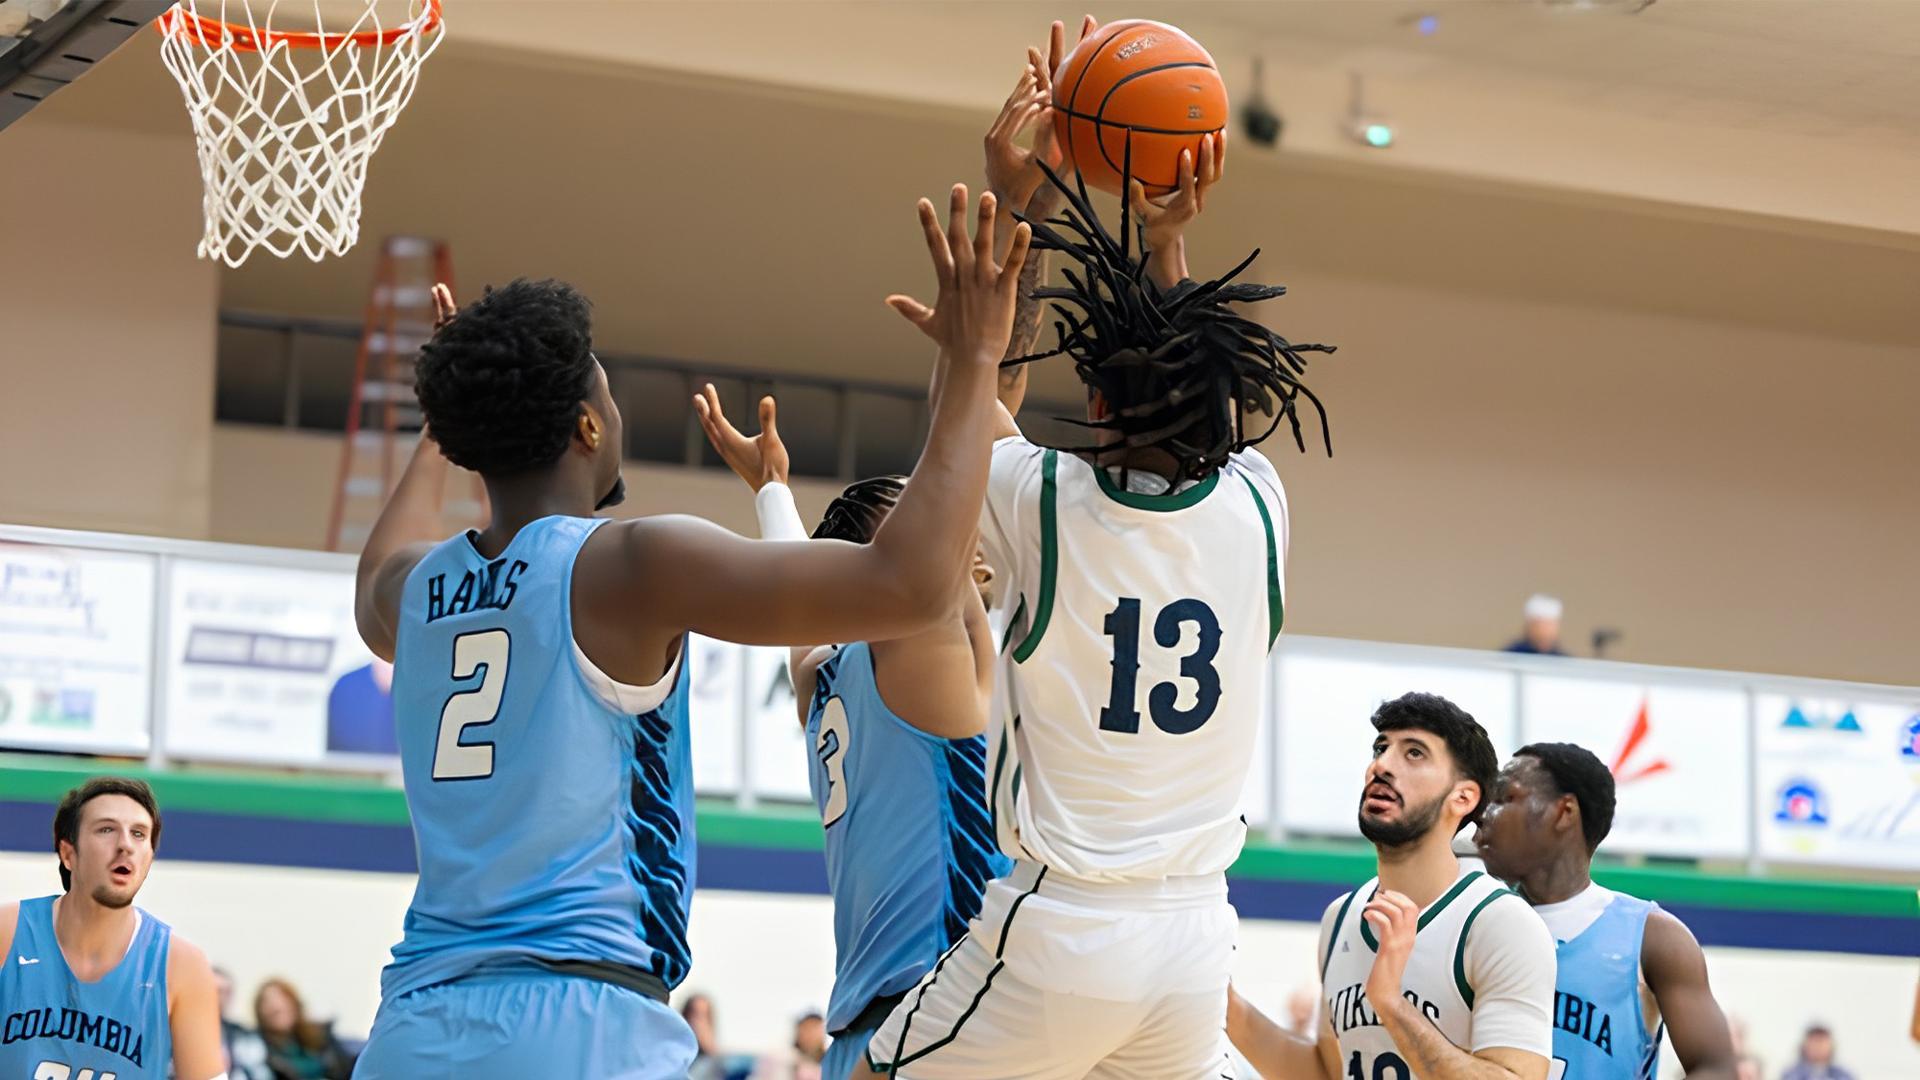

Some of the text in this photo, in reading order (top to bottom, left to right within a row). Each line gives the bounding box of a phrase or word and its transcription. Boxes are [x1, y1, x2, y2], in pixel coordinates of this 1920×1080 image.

[432, 627, 511, 781] 2
[1099, 597, 1223, 735] 13
[2, 1007, 144, 1069] COLUMBIA
